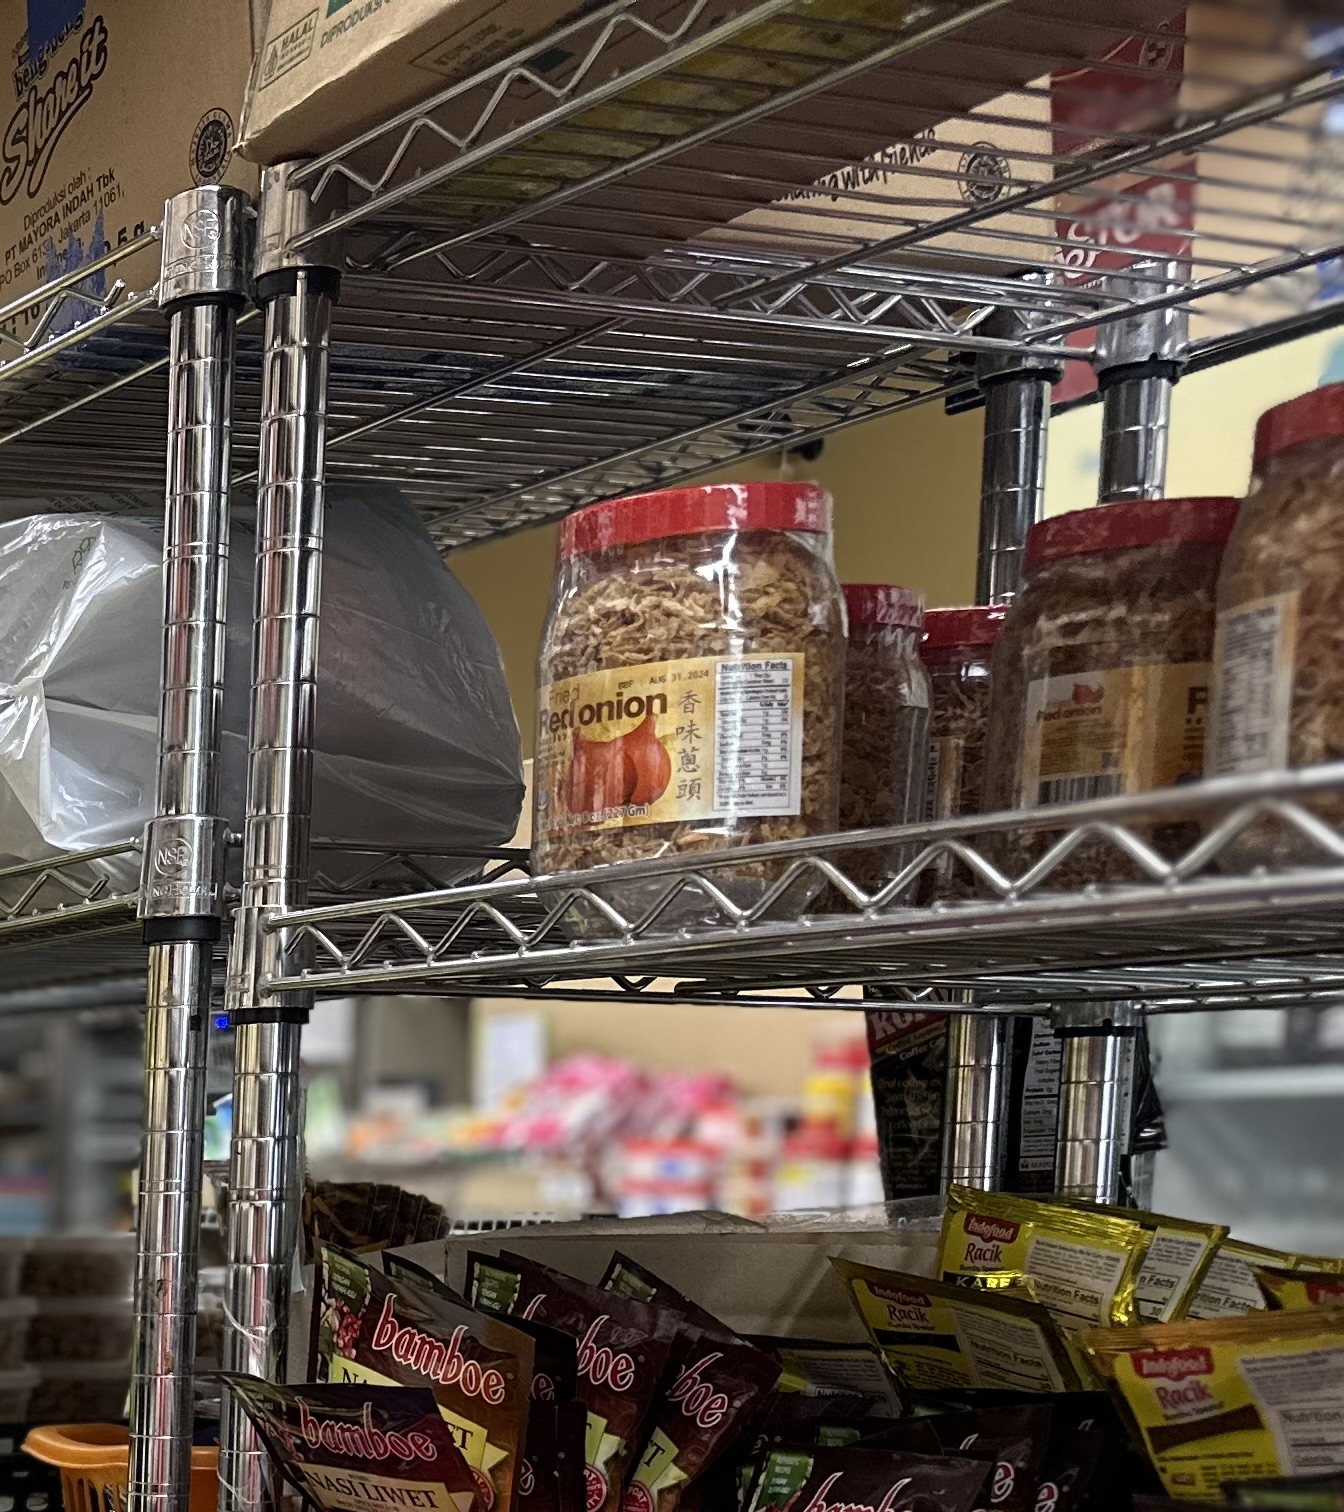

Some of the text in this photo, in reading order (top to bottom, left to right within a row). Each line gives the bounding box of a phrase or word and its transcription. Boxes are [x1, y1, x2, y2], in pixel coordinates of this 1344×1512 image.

[281, 17, 314, 50] HALAL
[4, 168, 116, 266] PT MAYORA INDAH Tbk
[23, 189, 67, 231] Diproduksi
[14, 256, 30, 281] Box
[57, 208, 91, 244] Jakarta
[578, 691, 668, 726] onion
[967, 1217, 1016, 1241] Indofood
[964, 1242, 1003, 1264] Racik
[1073, 1287, 1100, 1305] Facts
[1150, 1275, 1176, 1290] Facts
[887, 1304, 929, 1324] Racik
[372, 1293, 506, 1405] bamboe
[576, 1314, 635, 1391] boe
[668, 1352, 728, 1428] boe
[298, 1396, 438, 1462] bamboe
[305, 1468, 439, 1510] NASI LIWET
